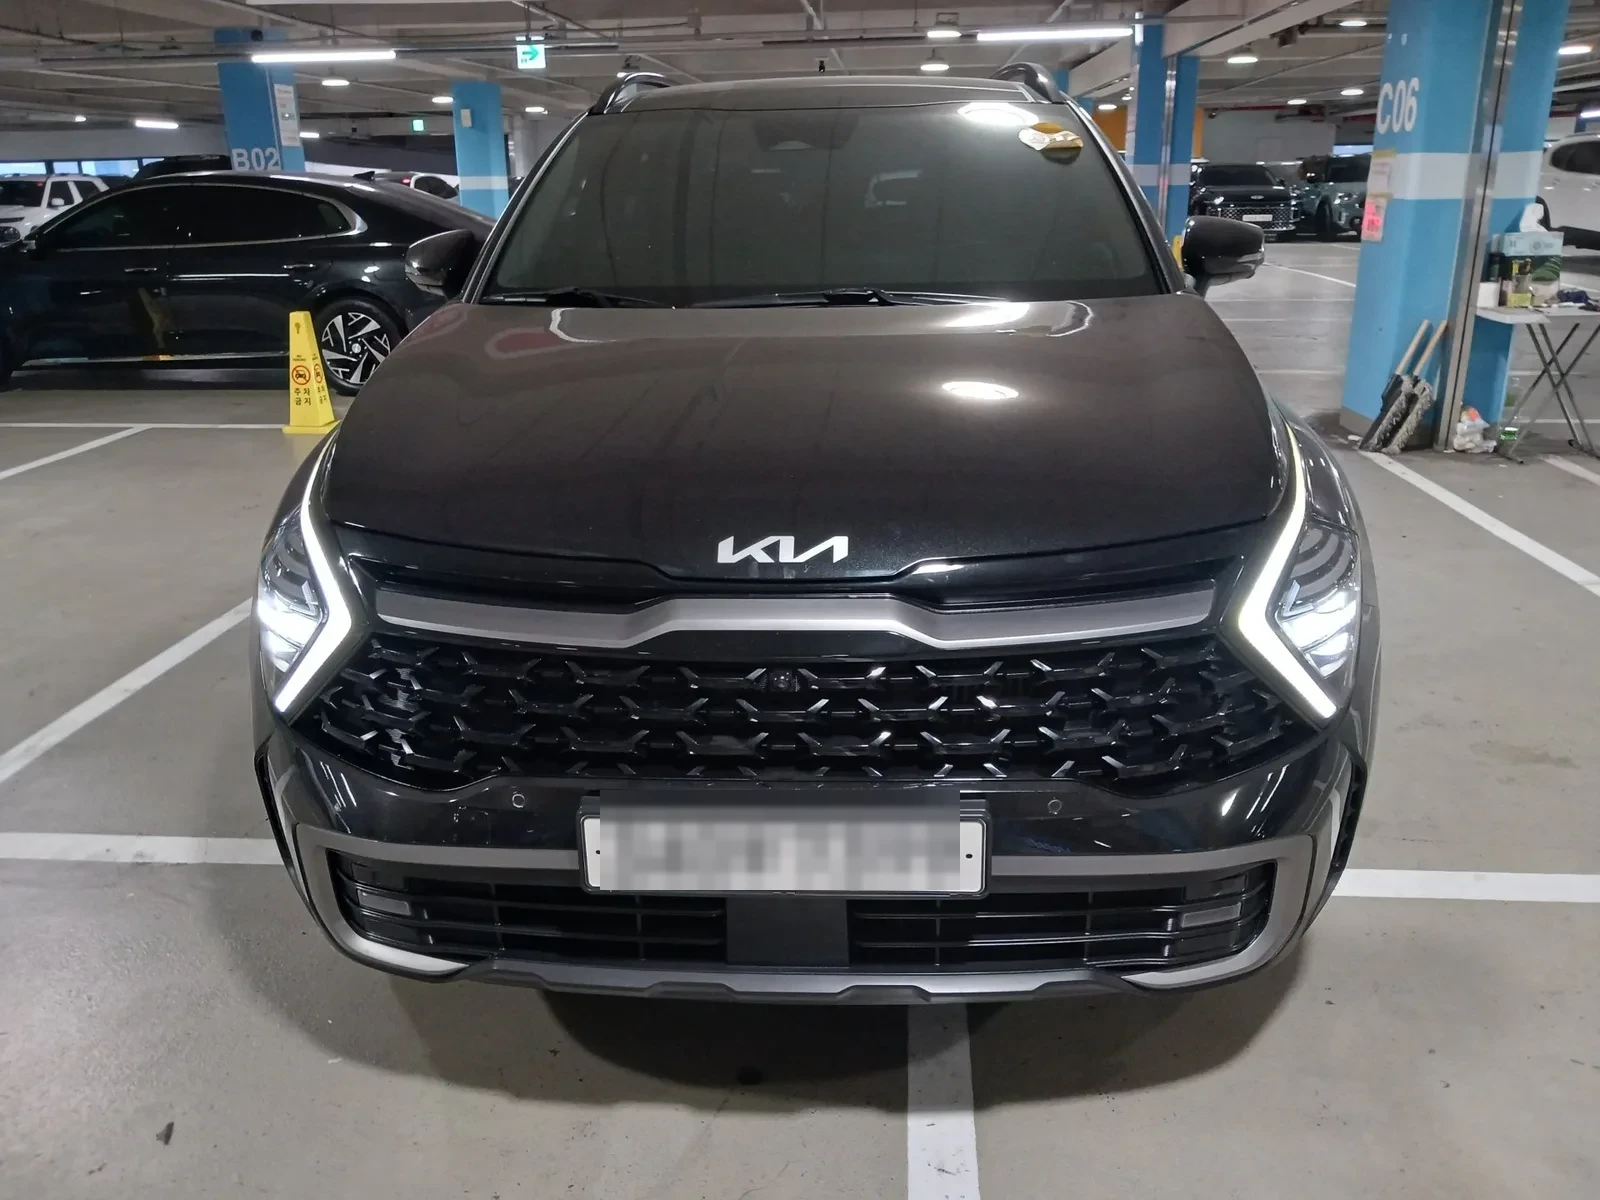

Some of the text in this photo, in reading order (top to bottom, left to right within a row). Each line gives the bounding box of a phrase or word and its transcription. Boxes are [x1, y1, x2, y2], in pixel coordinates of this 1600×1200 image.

[1376, 77, 1420, 134] C06
[231, 147, 281, 171] B02
[294, 387, 311, 396] 주차
[295, 397, 312, 406] 금지
[717, 535, 849, 564] KIA
